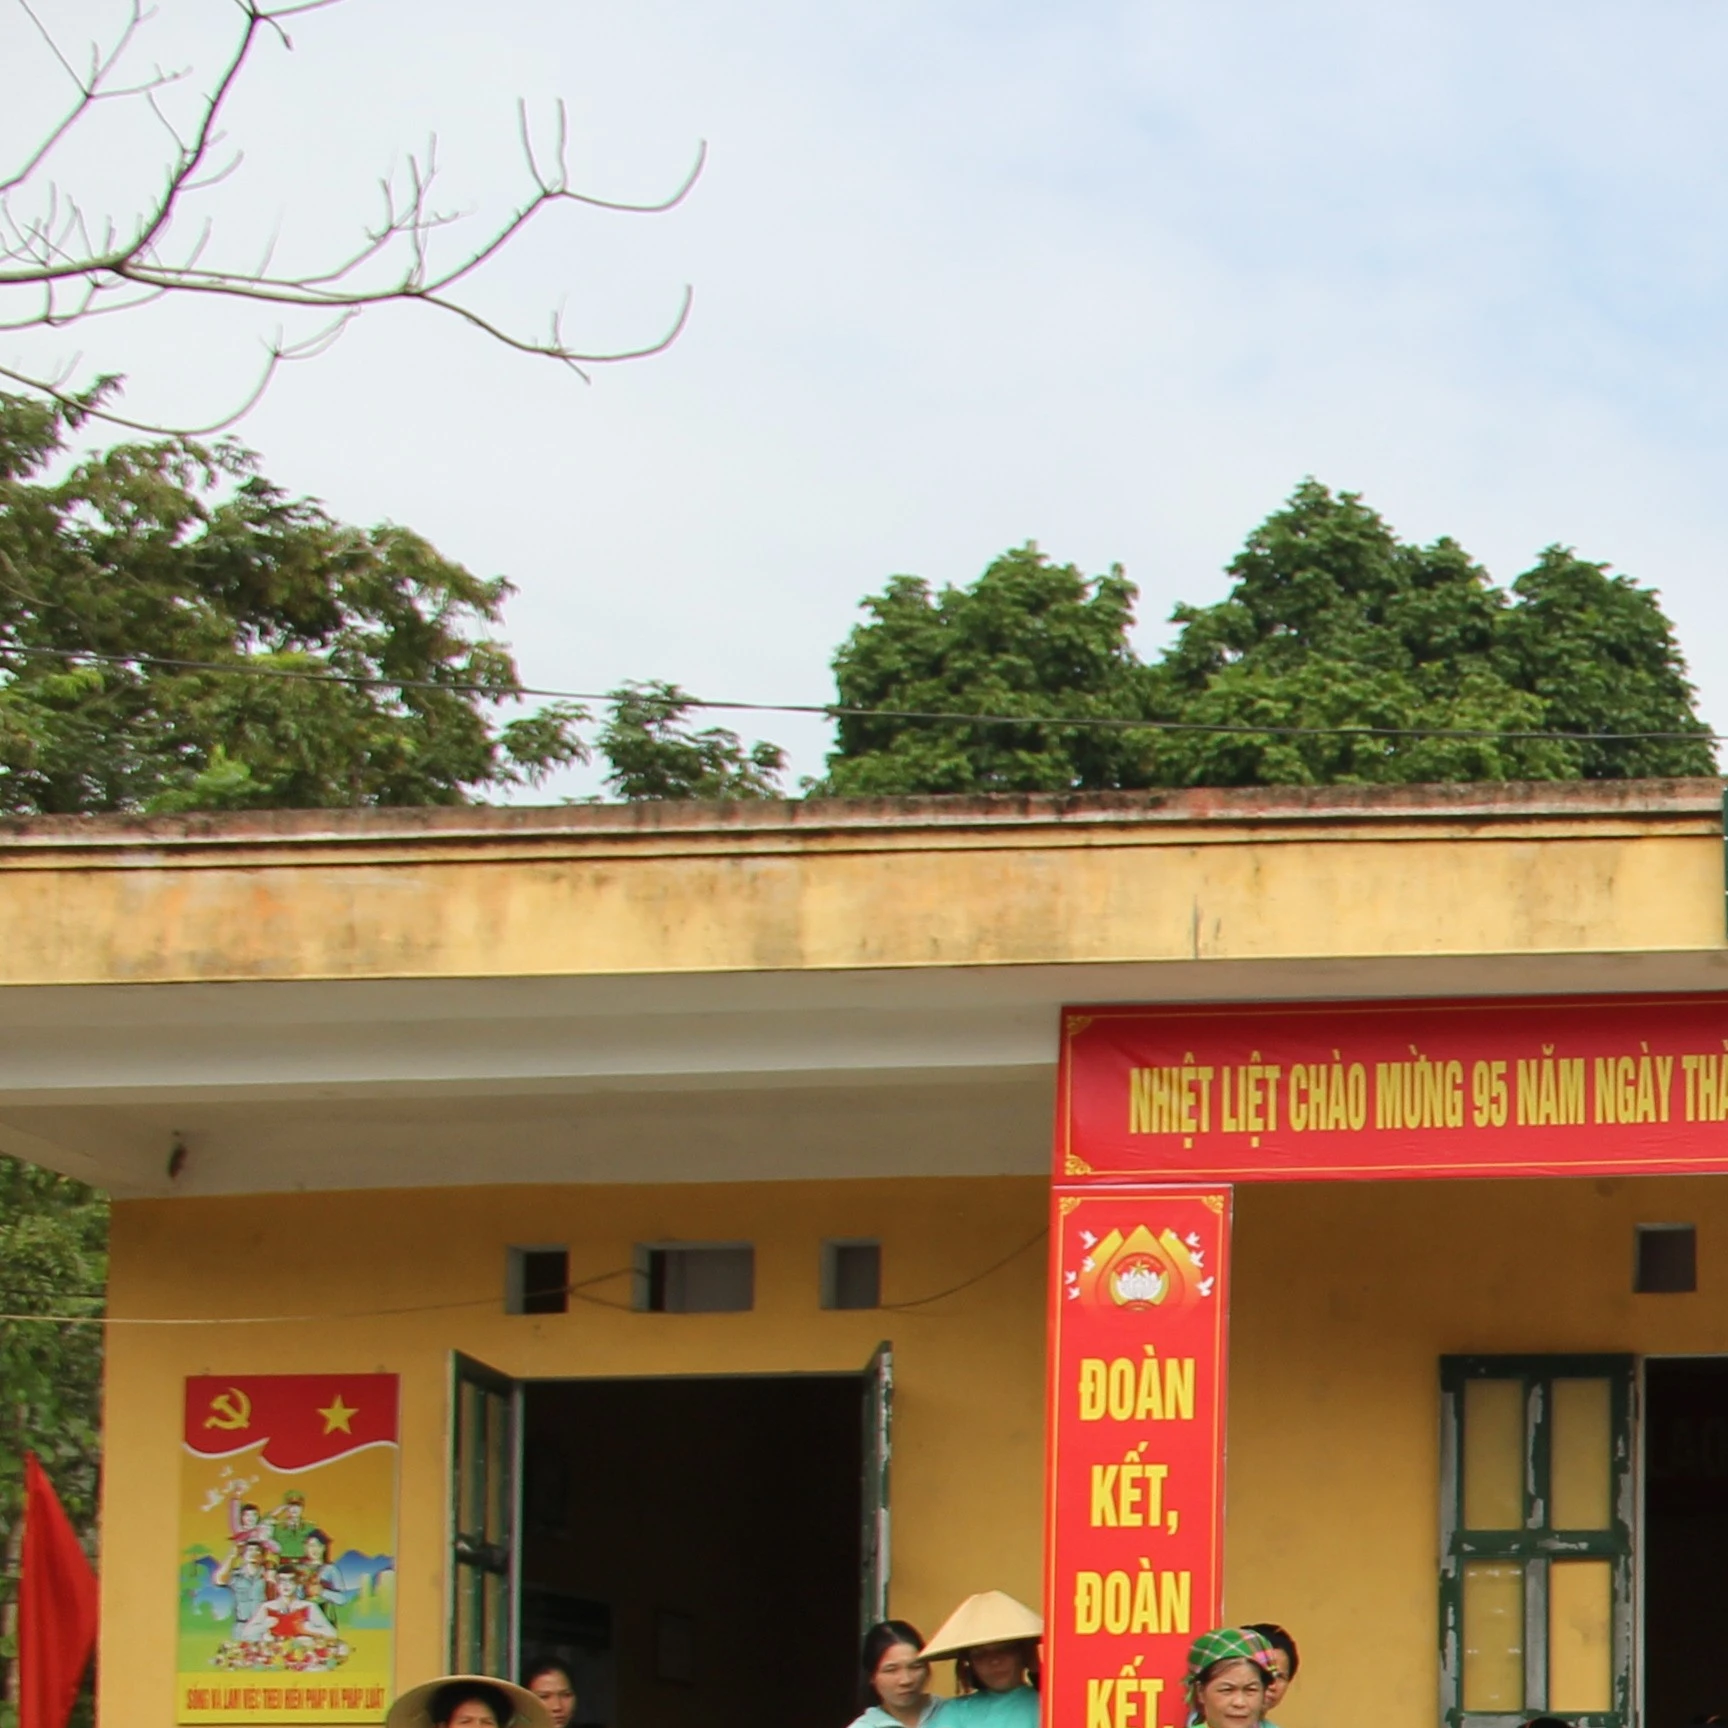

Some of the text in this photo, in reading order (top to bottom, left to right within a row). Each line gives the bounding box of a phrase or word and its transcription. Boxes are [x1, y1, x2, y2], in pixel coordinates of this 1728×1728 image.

[1129, 1052, 1214, 1149] NHIỆT
[1221, 1051, 1282, 1148] LIỆT
[1288, 1049, 1367, 1132] CHÀO
[1375, 1044, 1464, 1130] MỪNG
[1472, 1060, 1509, 1128] 95
[1516, 1044, 1586, 1126] NĂM
[1594, 1042, 1674, 1124] NGÀY
[1078, 1343, 1196, 1422] ĐOÀN
[1090, 1441, 1179, 1535] KẾT,
[1073, 1557, 1192, 1635] ĐOÀN
